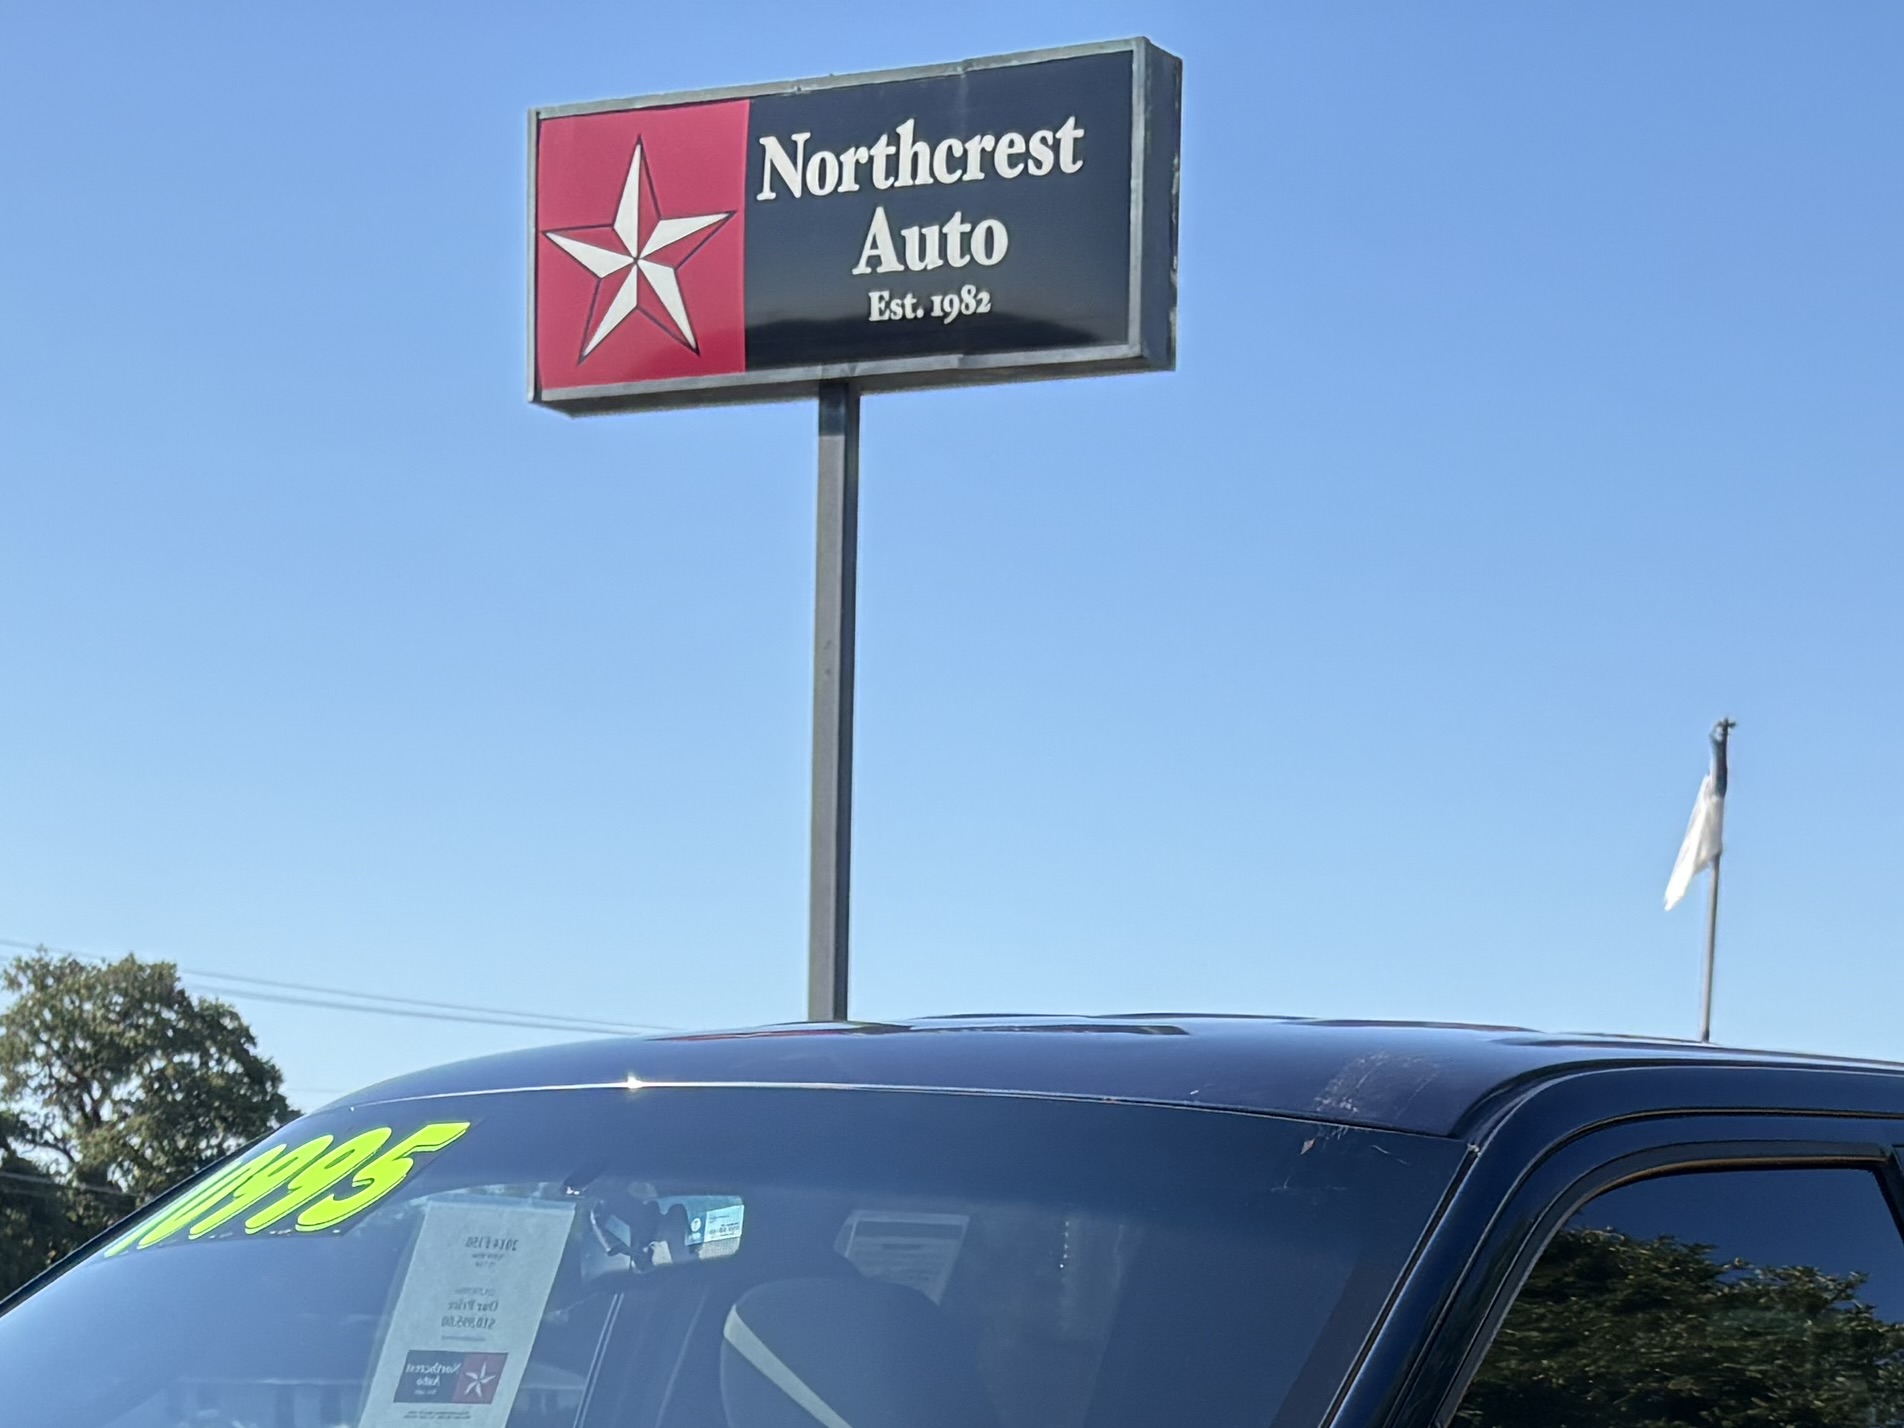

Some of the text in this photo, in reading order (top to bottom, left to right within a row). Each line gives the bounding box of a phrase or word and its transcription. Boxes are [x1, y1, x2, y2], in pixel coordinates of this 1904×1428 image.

[756, 115, 1085, 201] Northcrest
[851, 206, 1009, 275] Auto
[868, 284, 992, 325] Est. 1982
